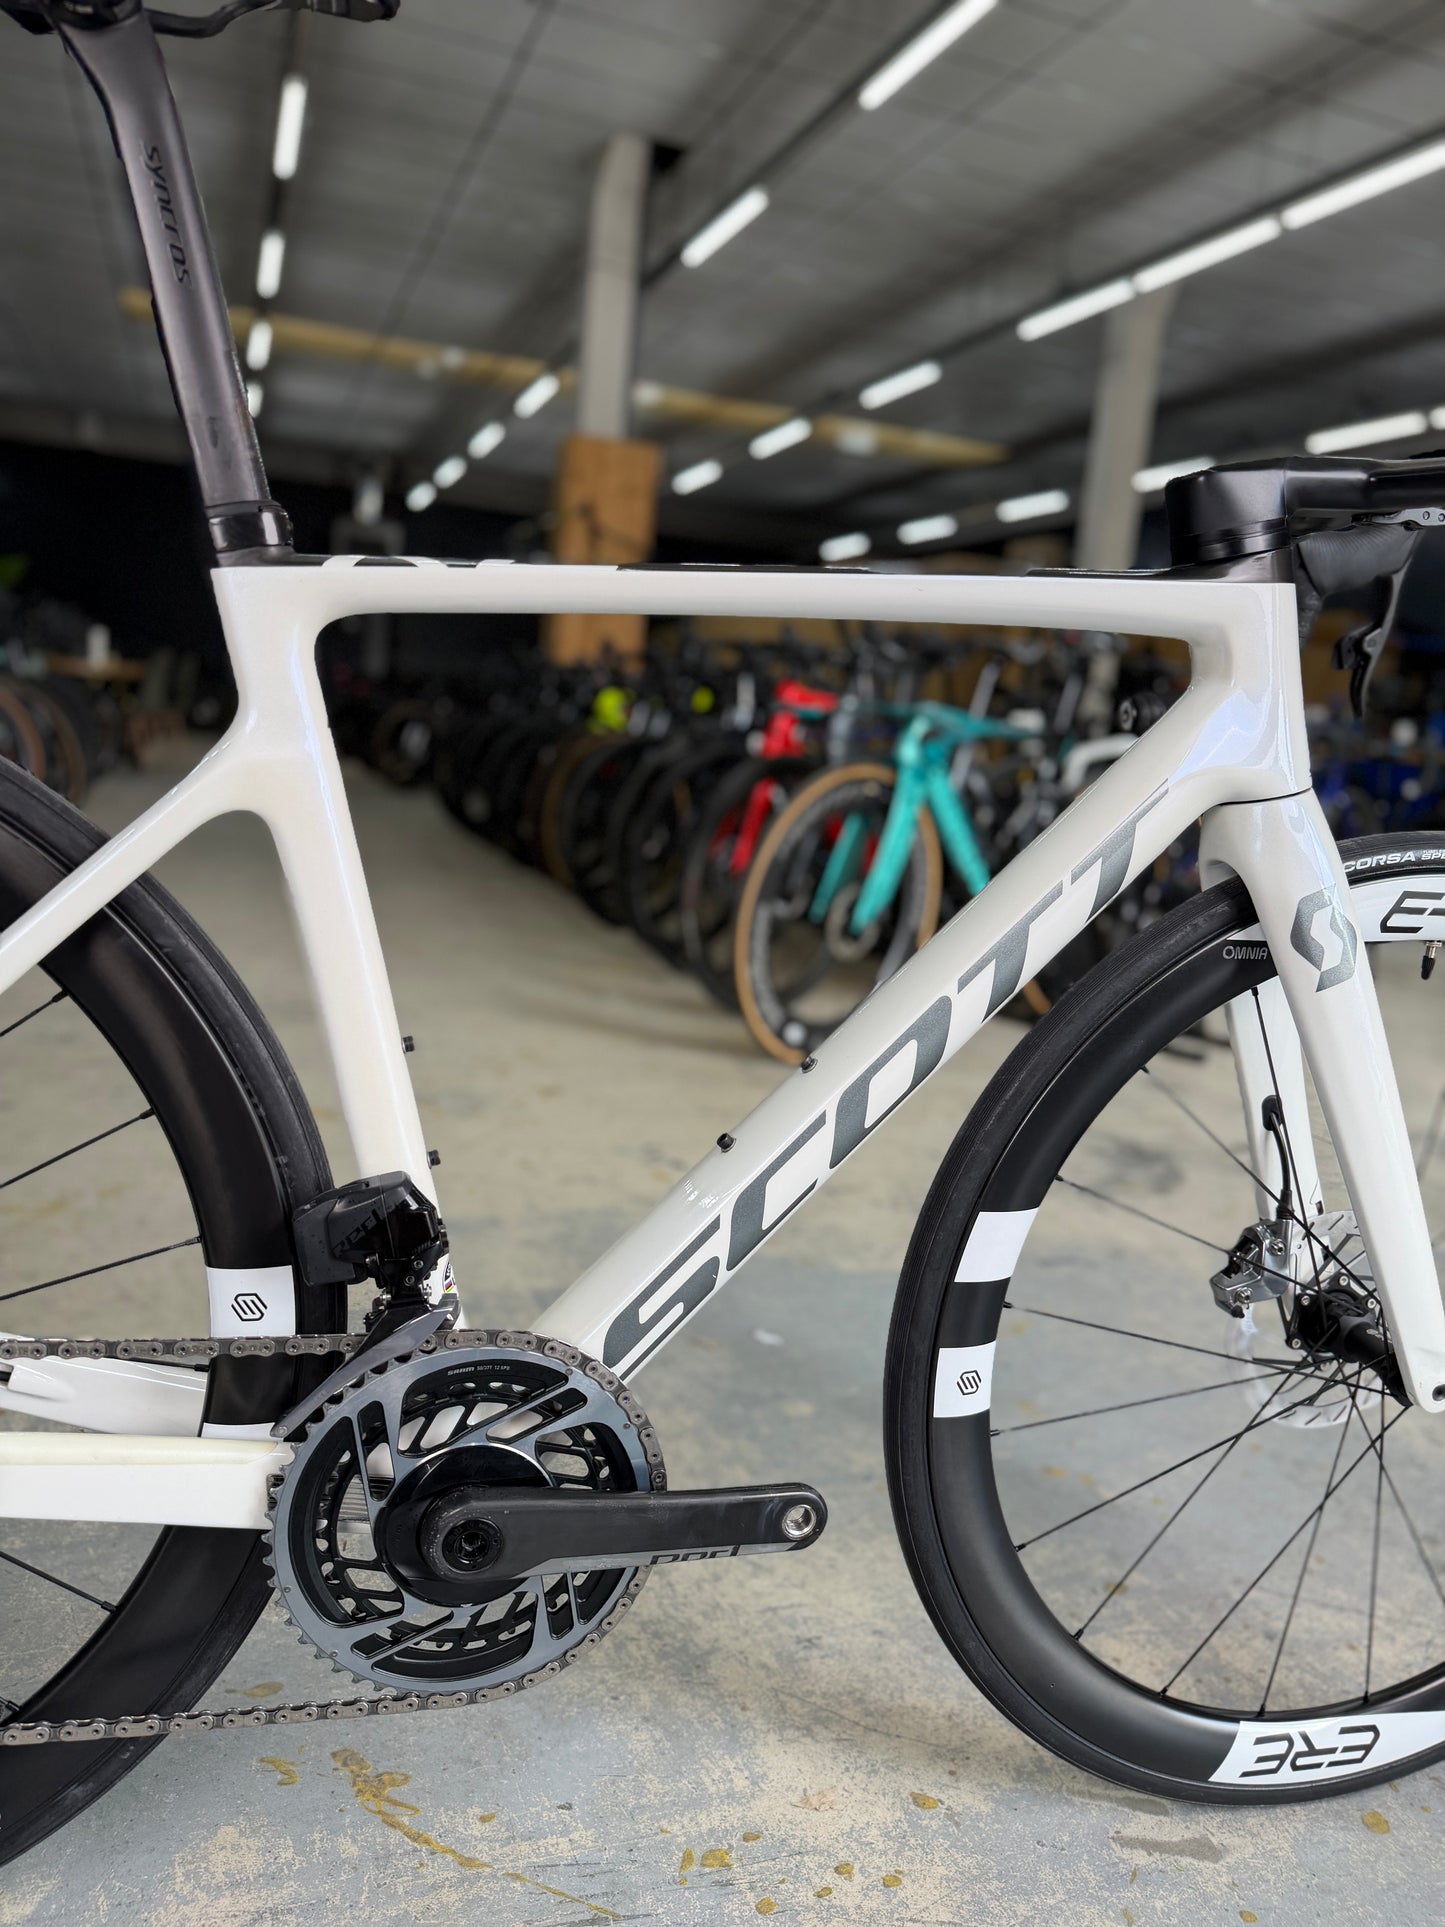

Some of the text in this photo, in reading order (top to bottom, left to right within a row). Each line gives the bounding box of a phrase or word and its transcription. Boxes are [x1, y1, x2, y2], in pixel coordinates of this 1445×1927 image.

[1343, 850, 1416, 873] CORSA
[1222, 945, 1268, 960] OMNIA
[603, 778, 1169, 1383] SCOTT
[1238, 1724, 1381, 1778] ERE
